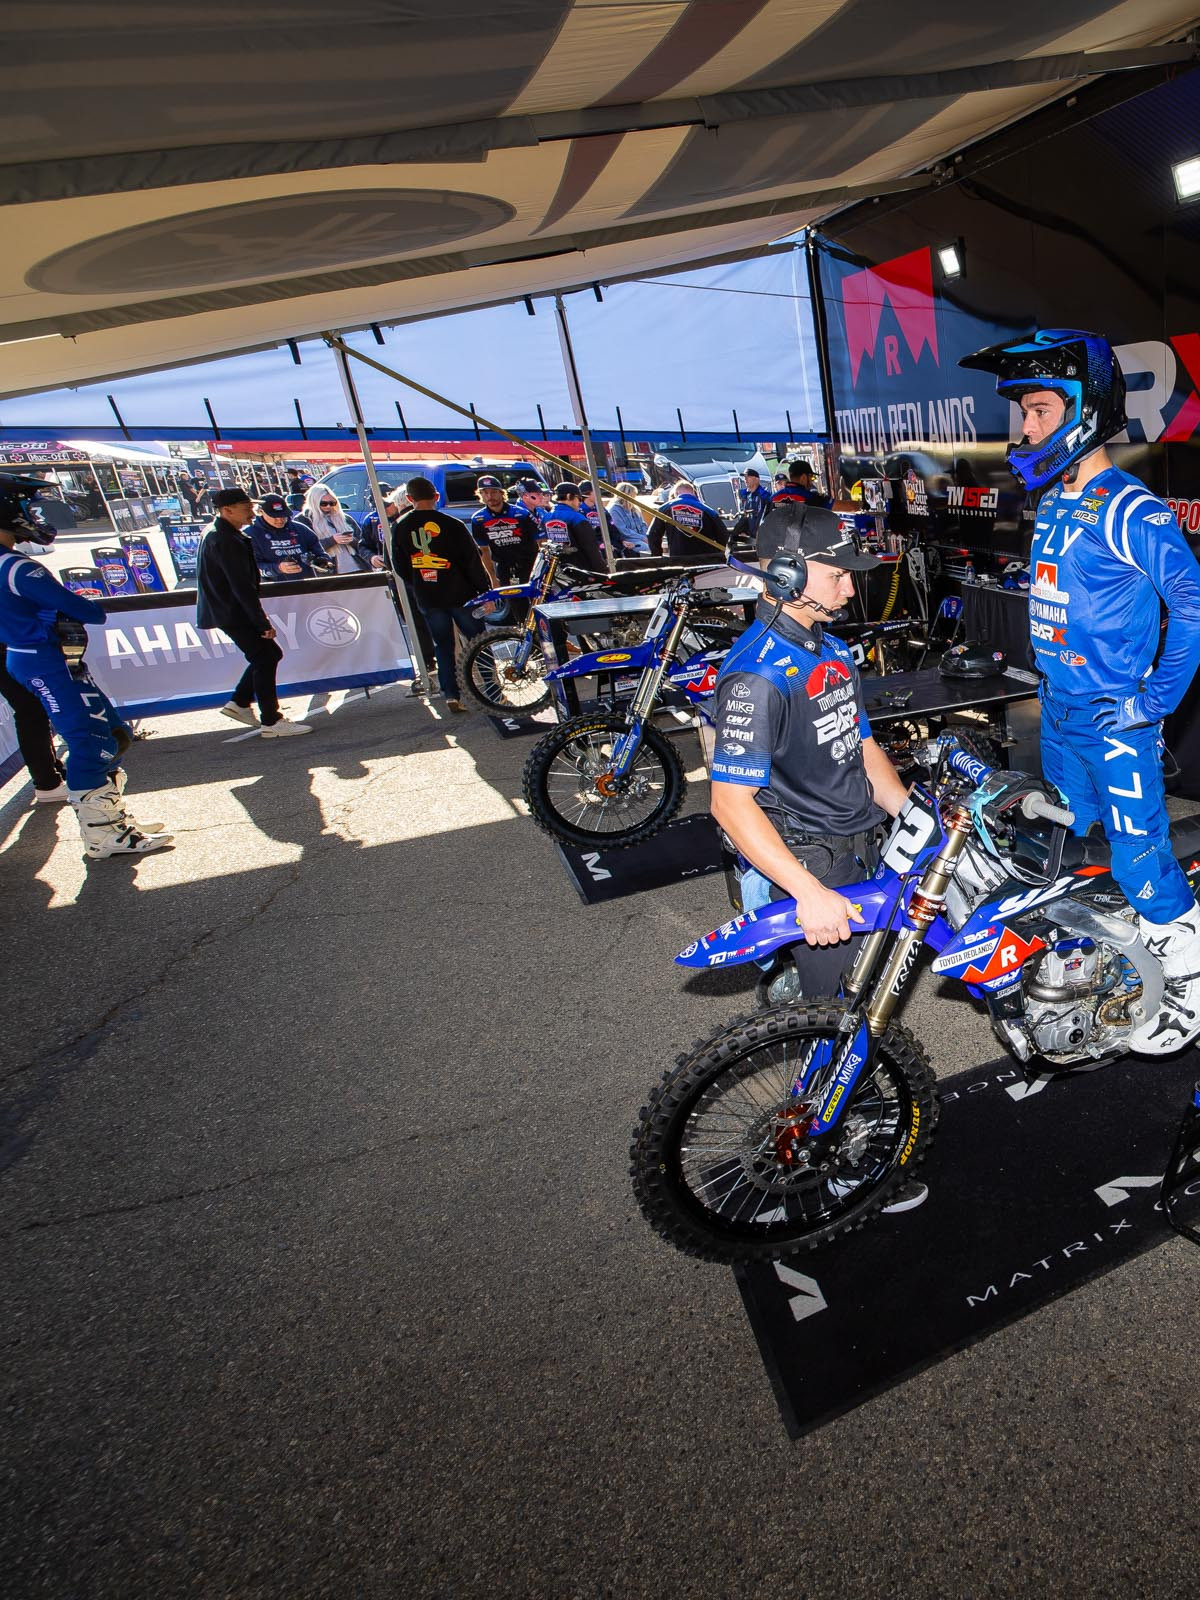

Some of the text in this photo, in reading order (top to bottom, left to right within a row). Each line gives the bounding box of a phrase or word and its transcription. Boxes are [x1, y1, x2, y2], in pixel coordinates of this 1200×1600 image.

[835, 396, 977, 452] TOYOTA REDLANDS
[1066, 410, 1098, 452] FLY
[948, 508, 998, 518] DEVELOPMENT
[1031, 522, 1084, 556] FLY
[1036, 601, 1068, 624] YAMAHA
[1031, 620, 1067, 646] BARX
[40, 686, 61, 713] YAMAHA
[812, 701, 858, 745] BAR
[728, 767, 765, 777] REDLANDS
[953, 751, 986, 779] Mika
[1103, 736, 1148, 836] FLY
[963, 925, 997, 945] BARX
[939, 943, 994, 968] TOYOTA REDLANDS
[1001, 944, 1018, 969] R
[838, 1053, 862, 1085] Mika
[900, 1105, 921, 1165] DUNLOP
[966, 1218, 1133, 1307] MATRIX
